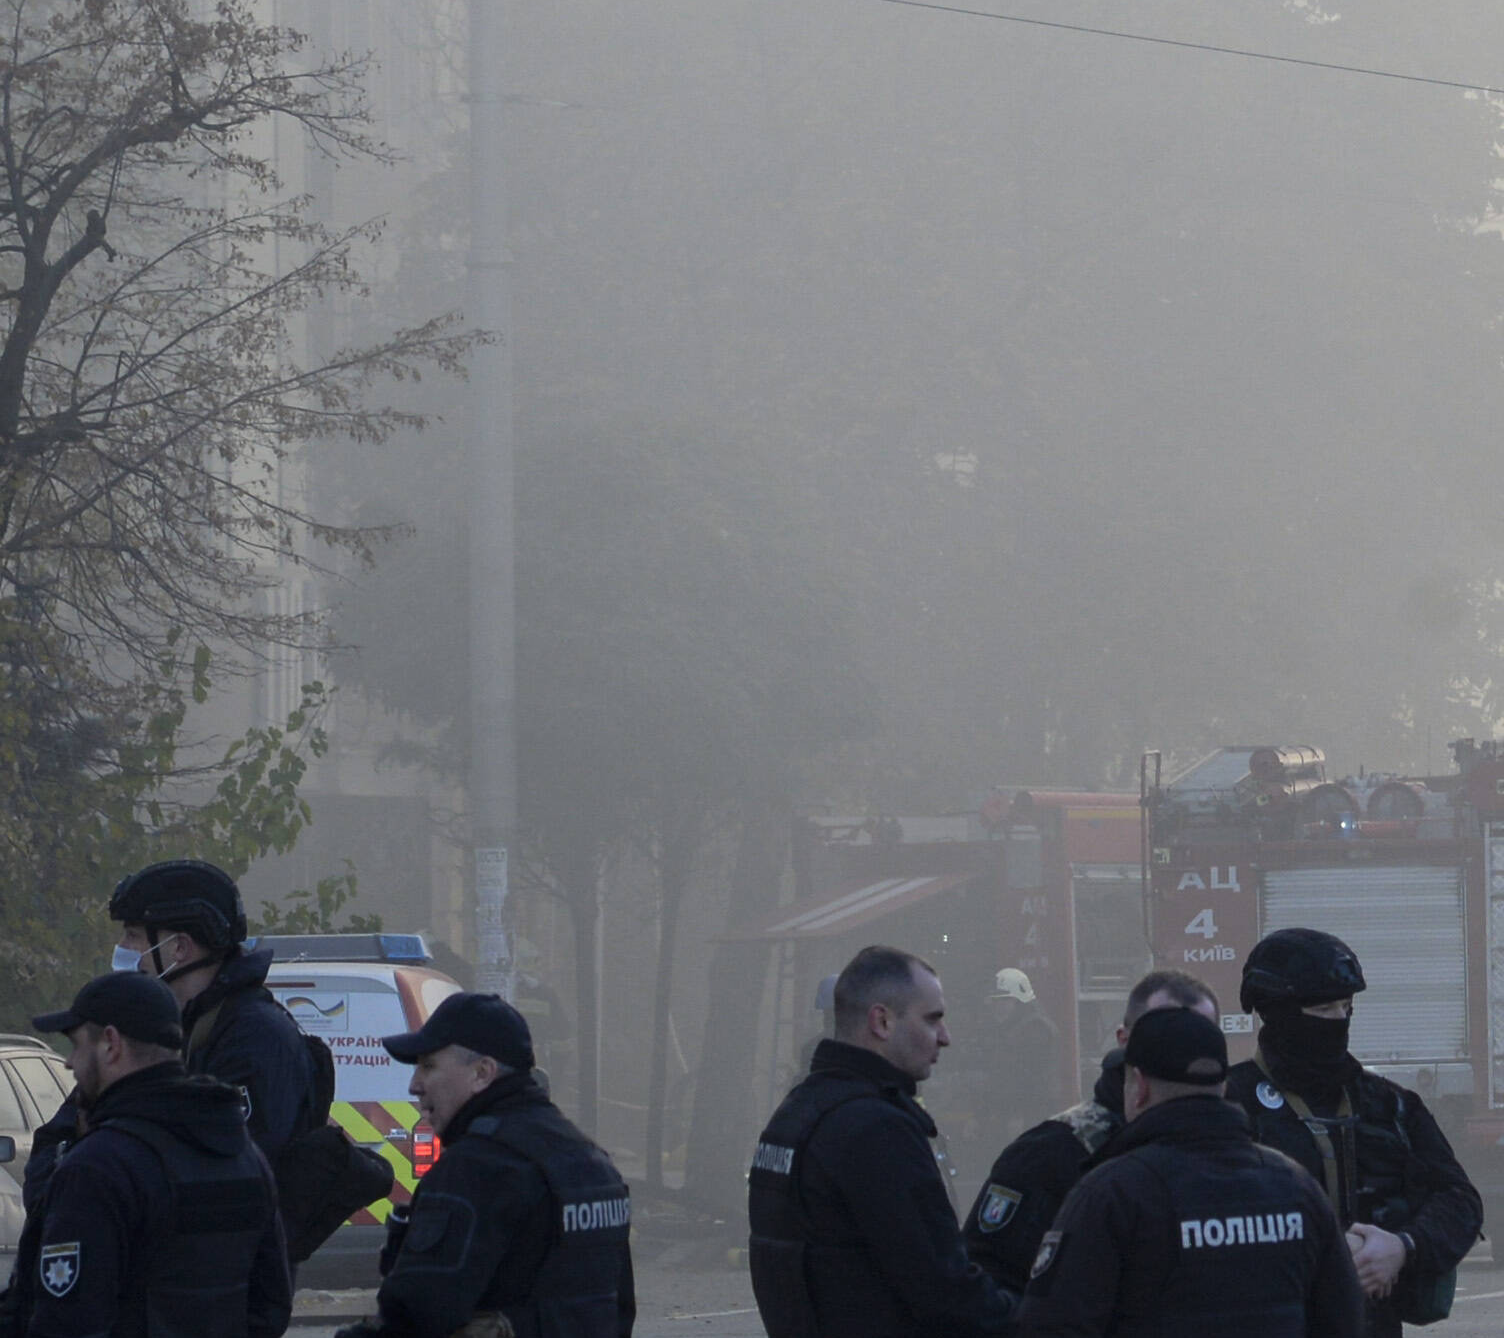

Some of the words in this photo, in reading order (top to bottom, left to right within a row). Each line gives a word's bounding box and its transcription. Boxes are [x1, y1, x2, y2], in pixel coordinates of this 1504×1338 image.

[1177, 866, 1241, 893] АЦ
[1184, 909, 1219, 939] 4
[563, 1198, 629, 1232] ПОЛІЦІЯ
[1180, 1212, 1304, 1249] ПОЛІЦІЯ
